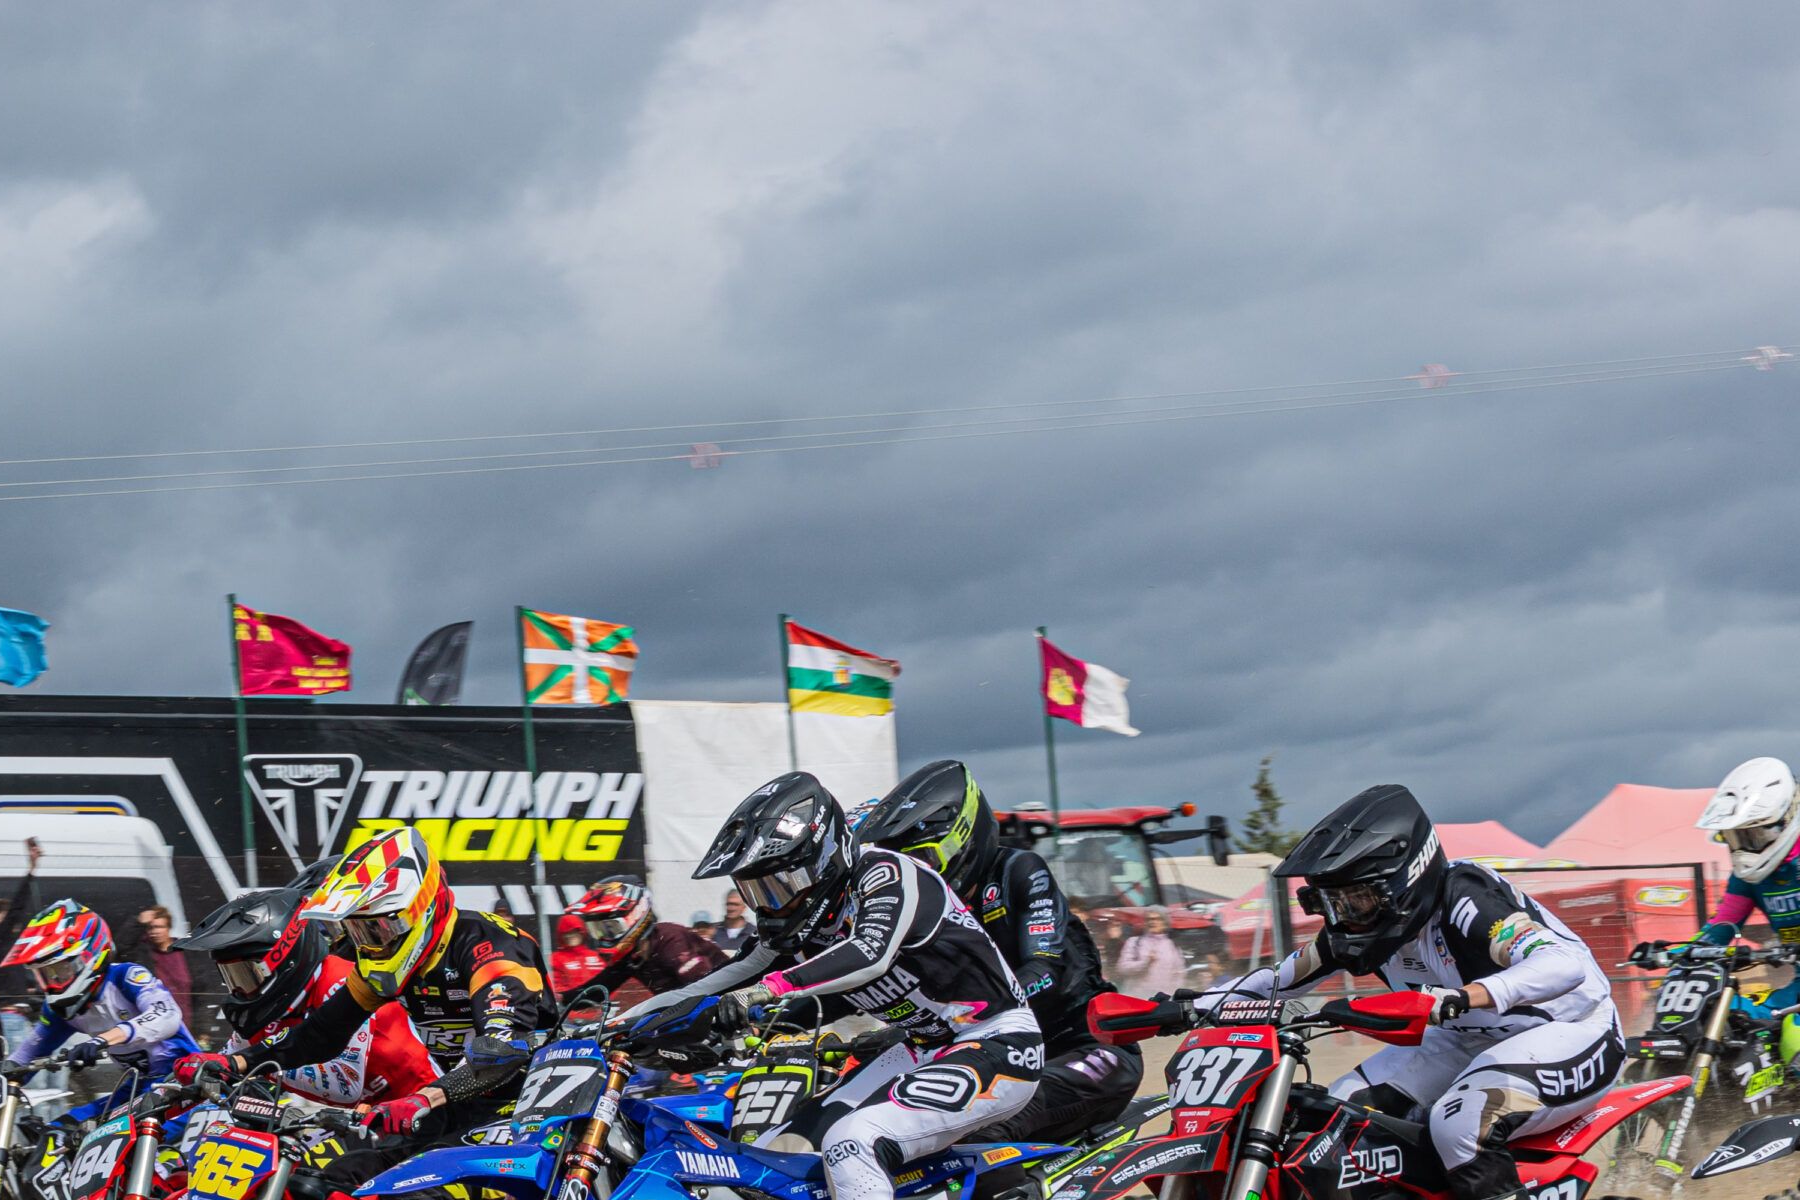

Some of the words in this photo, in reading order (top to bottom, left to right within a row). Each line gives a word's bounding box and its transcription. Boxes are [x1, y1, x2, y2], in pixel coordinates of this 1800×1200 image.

[262, 764, 340, 780] TRIUMPH
[361, 771, 643, 819] TRIUMPH
[843, 965, 921, 1010] MAHA
[1657, 980, 1710, 1013] 86
[1220, 1010, 1280, 1020] RENTHAL
[1169, 1047, 1264, 1109] 337
[1536, 1041, 1609, 1096] SHOT
[512, 1065, 599, 1116] 37
[234, 1102, 283, 1118] RENTHAL
[1143, 1102, 1172, 1117] DUNL
[484, 1160, 528, 1172] VERTEX
[676, 1150, 741, 1179] YAMAHA
[822, 1138, 861, 1168] aero
[1337, 1145, 1404, 1190] BUD
[188, 1141, 267, 1200] 365
